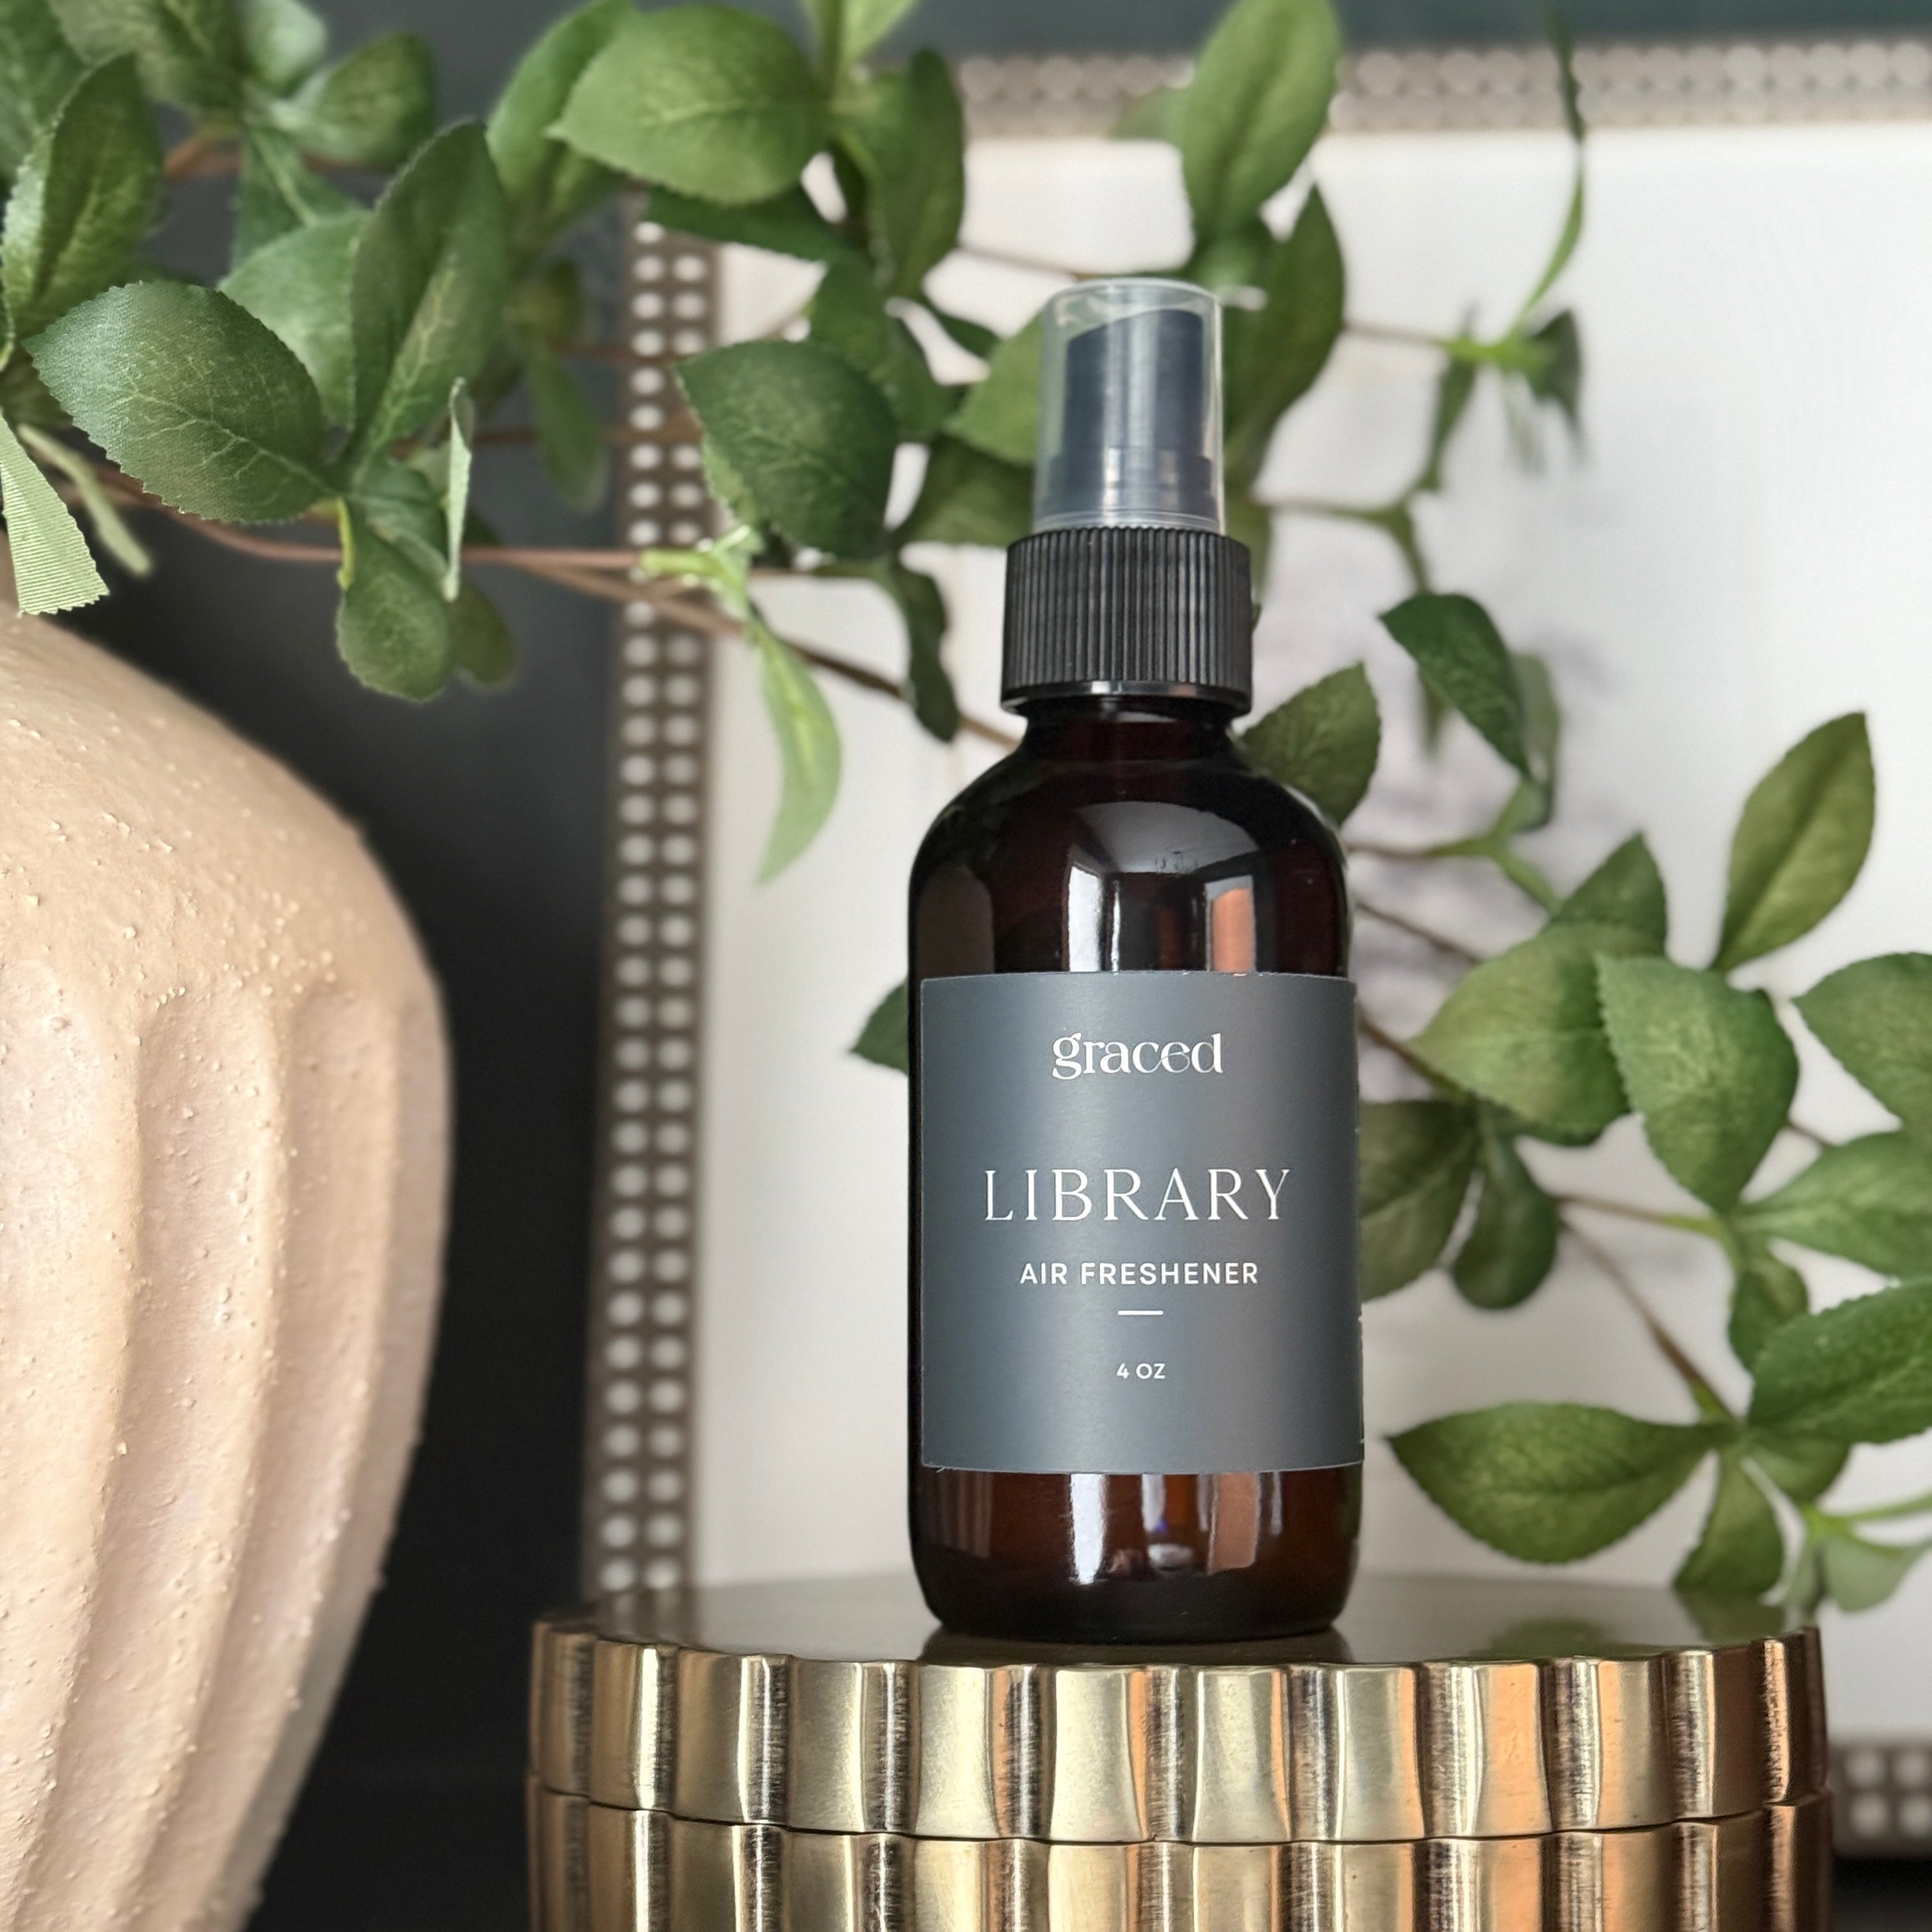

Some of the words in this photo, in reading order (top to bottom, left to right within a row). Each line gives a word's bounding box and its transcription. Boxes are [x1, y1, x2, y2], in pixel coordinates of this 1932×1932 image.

[1052, 1032, 1223, 1080] graced
[985, 1168, 1290, 1221] LIBRARY
[1020, 1262, 1067, 1285] AIR
[1081, 1262, 1258, 1285] FRESHENER
[1116, 1363, 1130, 1379] 4
[1136, 1363, 1165, 1379] OZ
